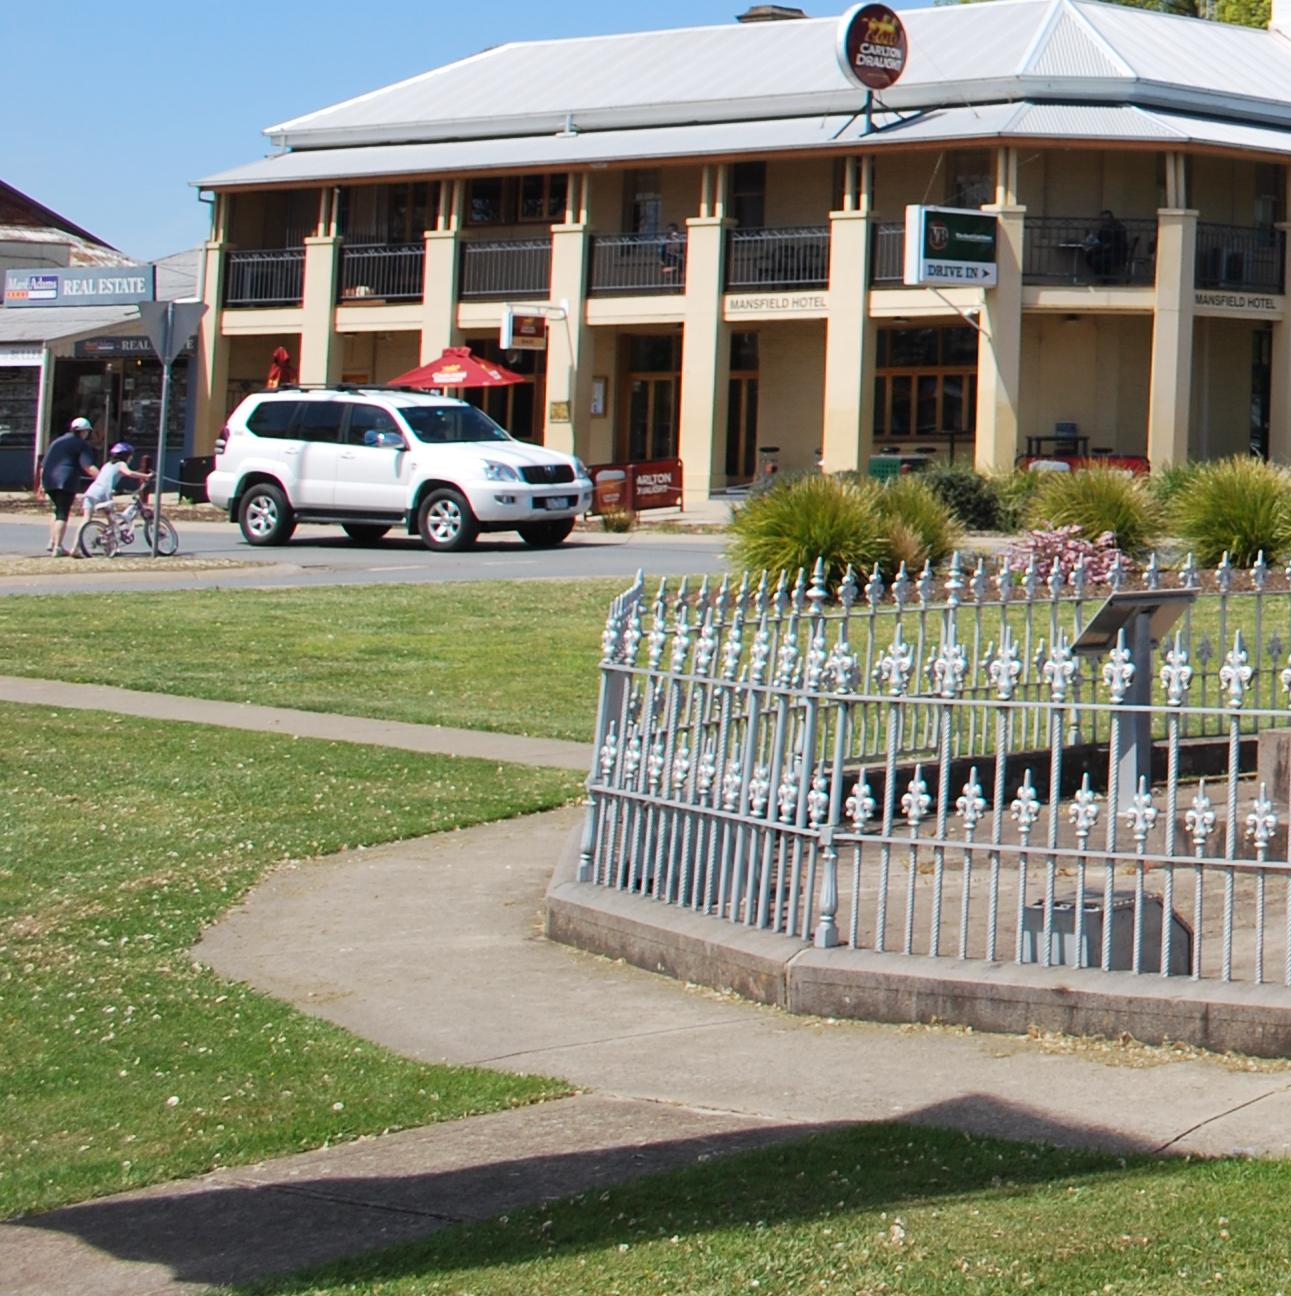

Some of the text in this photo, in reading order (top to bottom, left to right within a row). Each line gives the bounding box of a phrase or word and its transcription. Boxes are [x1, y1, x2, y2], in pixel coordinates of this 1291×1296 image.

[860, 42, 903, 59] CARLTON
[856, 53, 902, 71] DRAUGHT
[927, 265, 978, 278] DRIVE IN
[63, 277, 146, 296] REAL ESTATE
[730, 296, 827, 310] MANSFIELD HOTEL
[1195, 294, 1277, 309] MANSFIELD HOTEL
[121, 339, 150, 351] REAL
[636, 473, 672, 484] ARLTON
